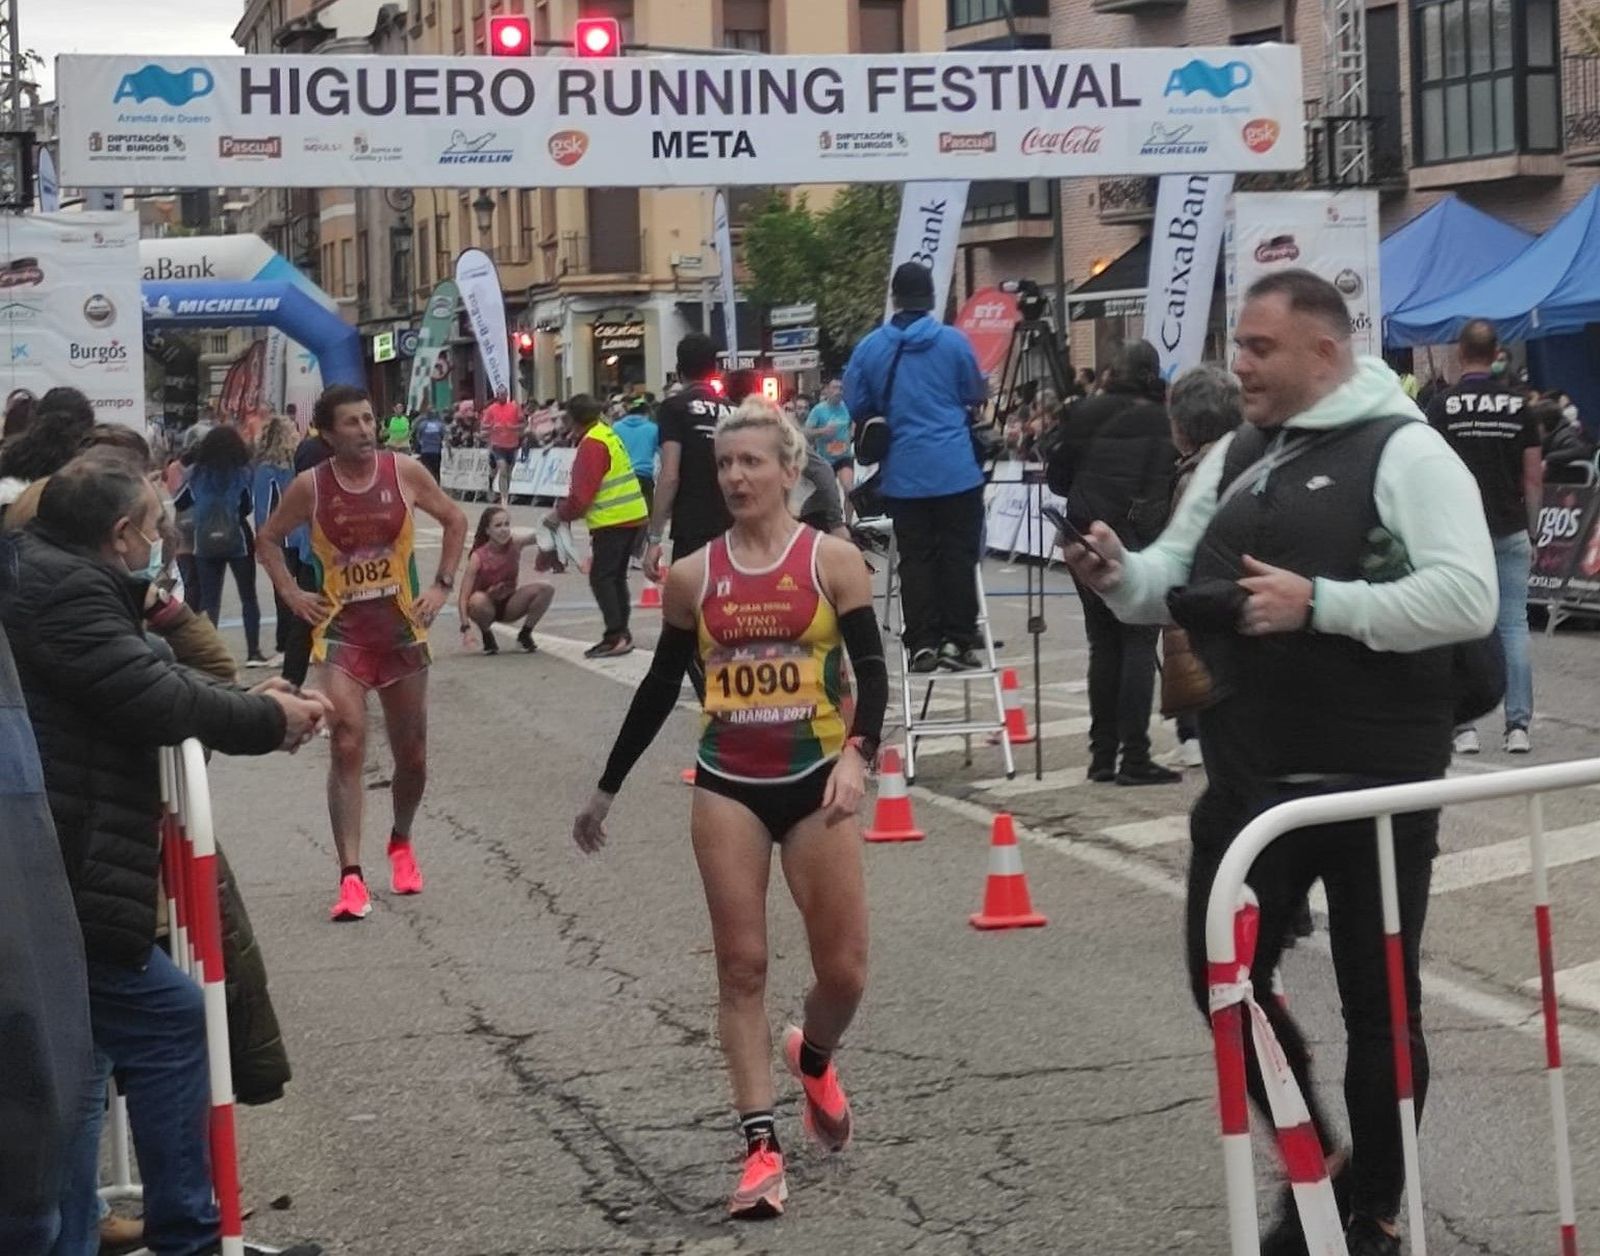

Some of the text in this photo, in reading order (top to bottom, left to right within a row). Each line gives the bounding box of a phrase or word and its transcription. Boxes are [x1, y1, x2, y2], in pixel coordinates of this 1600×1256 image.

[239, 63, 1142, 117] HIGUERO RUNNING FESTIVAL
[117, 113, 211, 124] Aranda de Duero
[107, 133, 170, 143] DIPUTACIÓN
[942, 134, 994, 149] Pascual
[1245, 124, 1275, 147] gsk
[107, 144, 170, 152] DE BURGOS
[223, 140, 279, 153] Pascual
[550, 137, 583, 157] gsk
[651, 129, 757, 159] META
[836, 141, 894, 150] DE BURGOS
[1140, 145, 1208, 155] MICHELIN
[438, 153, 513, 164] MICHELIN
[176, 297, 282, 314] MICHELIN
[70, 343, 127, 364] Burgos
[1445, 393, 1524, 416] STAFF
[341, 559, 392, 587] 1082
[736, 615, 777, 627] VINO
[746, 627, 792, 638] TORO
[716, 661, 800, 699] 1090
[730, 707, 780, 724] ARANDA
